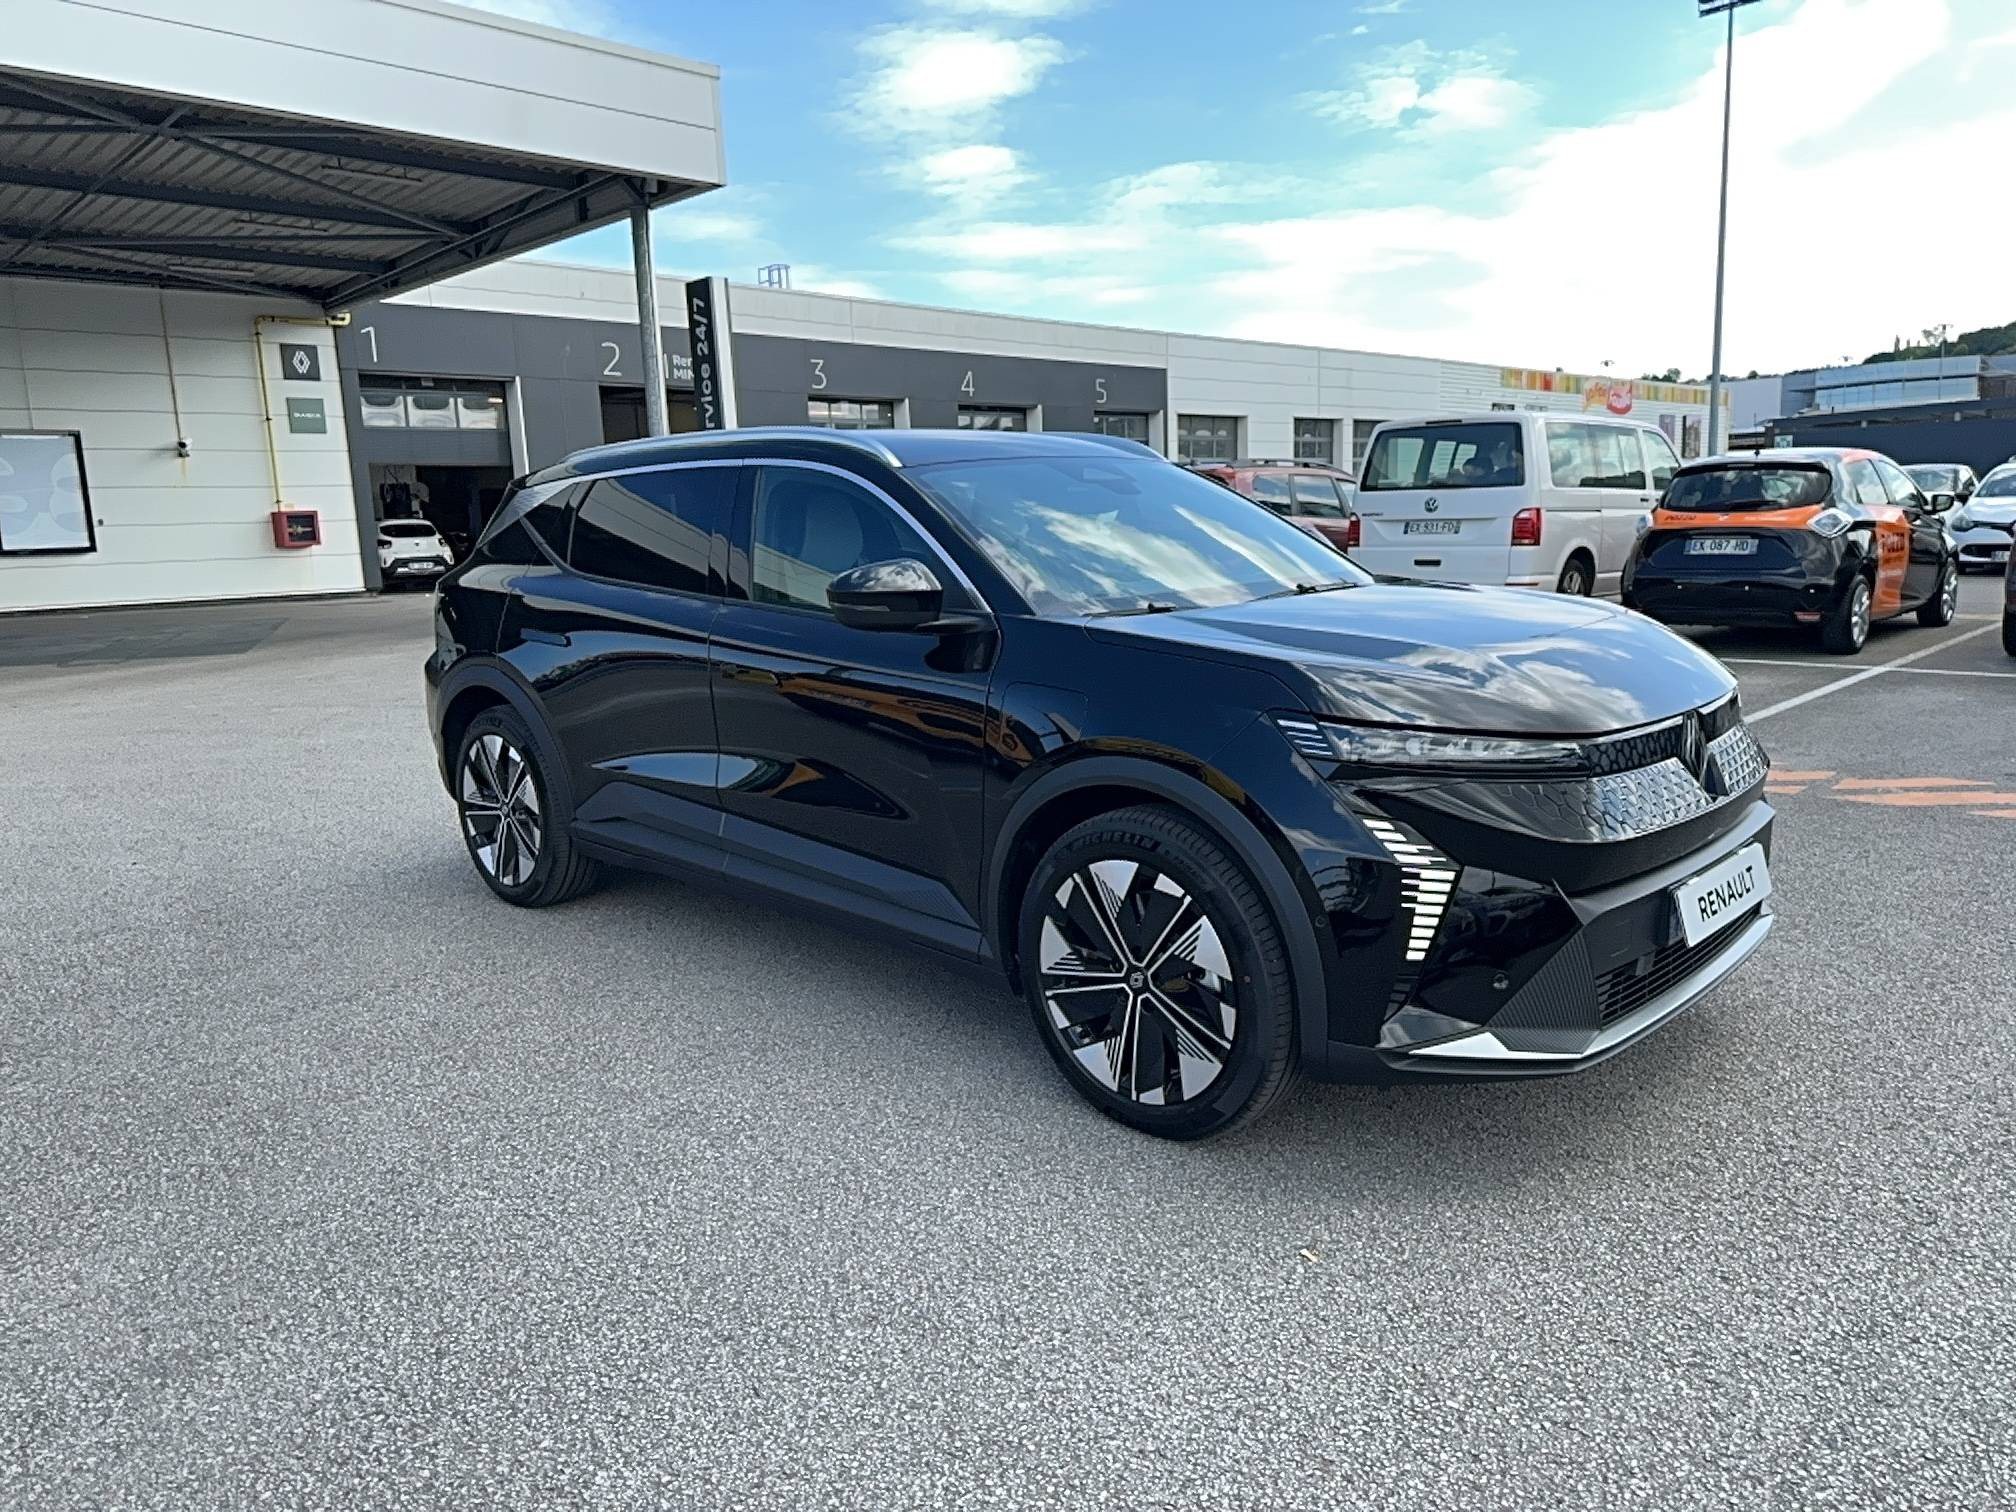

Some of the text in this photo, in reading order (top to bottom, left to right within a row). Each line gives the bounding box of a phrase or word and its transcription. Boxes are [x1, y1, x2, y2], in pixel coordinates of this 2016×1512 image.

[360, 326, 378, 363] 1
[601, 341, 622, 376] 2
[692, 297, 716, 429] rvice 24/7
[809, 358, 828, 390] 3
[960, 370, 976, 397] 4
[1095, 378, 1108, 404] 5
[1696, 864, 1755, 922] RENAULT
